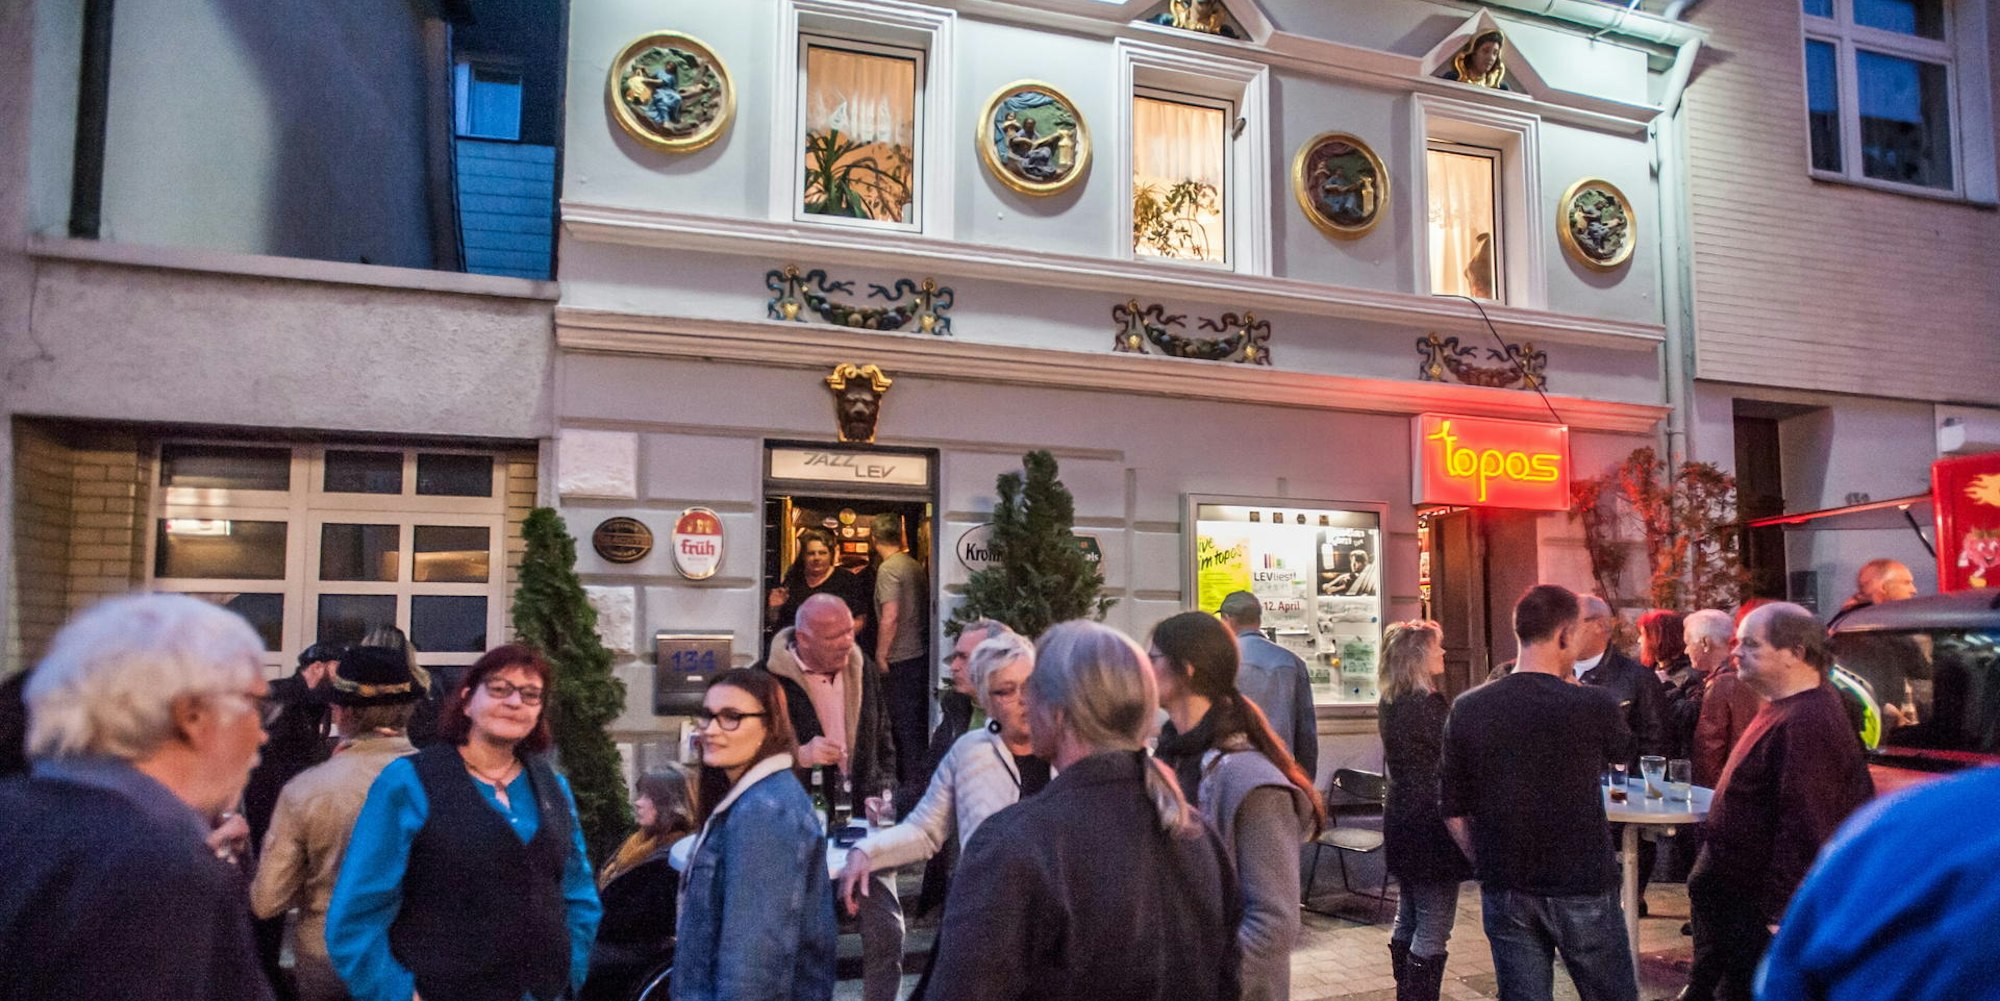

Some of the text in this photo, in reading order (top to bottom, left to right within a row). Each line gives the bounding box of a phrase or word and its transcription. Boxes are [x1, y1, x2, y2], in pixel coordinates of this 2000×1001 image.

[803, 451, 855, 467] JAZZ
[1427, 420, 1562, 502] topos
[855, 465, 896, 479] LEV
[681, 539, 715, 556] früh
[1264, 601, 1301, 613] 12. April
